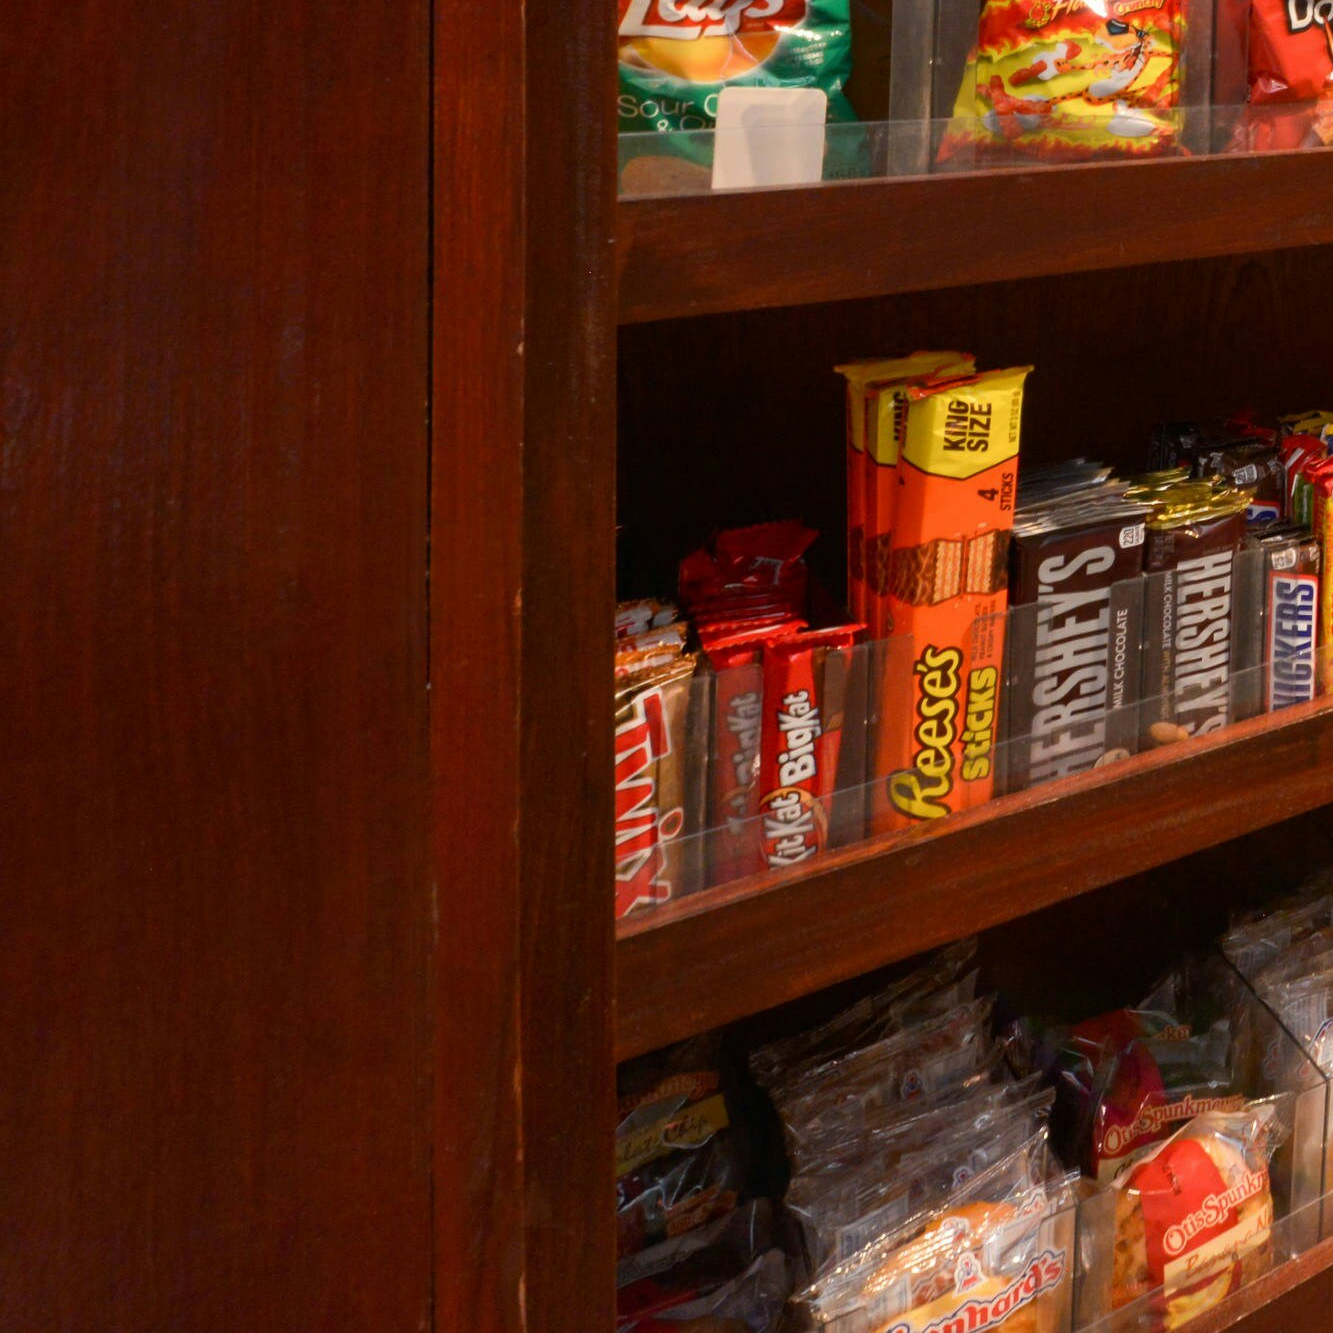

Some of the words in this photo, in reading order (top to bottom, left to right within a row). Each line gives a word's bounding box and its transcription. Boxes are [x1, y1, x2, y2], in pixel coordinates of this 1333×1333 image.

[618, 94, 694, 118] Sour
[943, 400, 969, 451] KING
[966, 402, 992, 452] SIZE
[978, 489, 999, 501] 4
[1000, 472, 1014, 511] STICKS
[1163, 571, 1173, 593] MILK
[1116, 608, 1128, 677] CHOCOLATE
[1162, 594, 1172, 650] CHOCOLATE
[1176, 550, 1234, 735] HERSHEY'S
[1271, 582, 1316, 713] NICKERS
[1029, 546, 1116, 784] HERSHEY'S
[1114, 679, 1126, 709] MILK
[889, 646, 963, 819] Reese's
